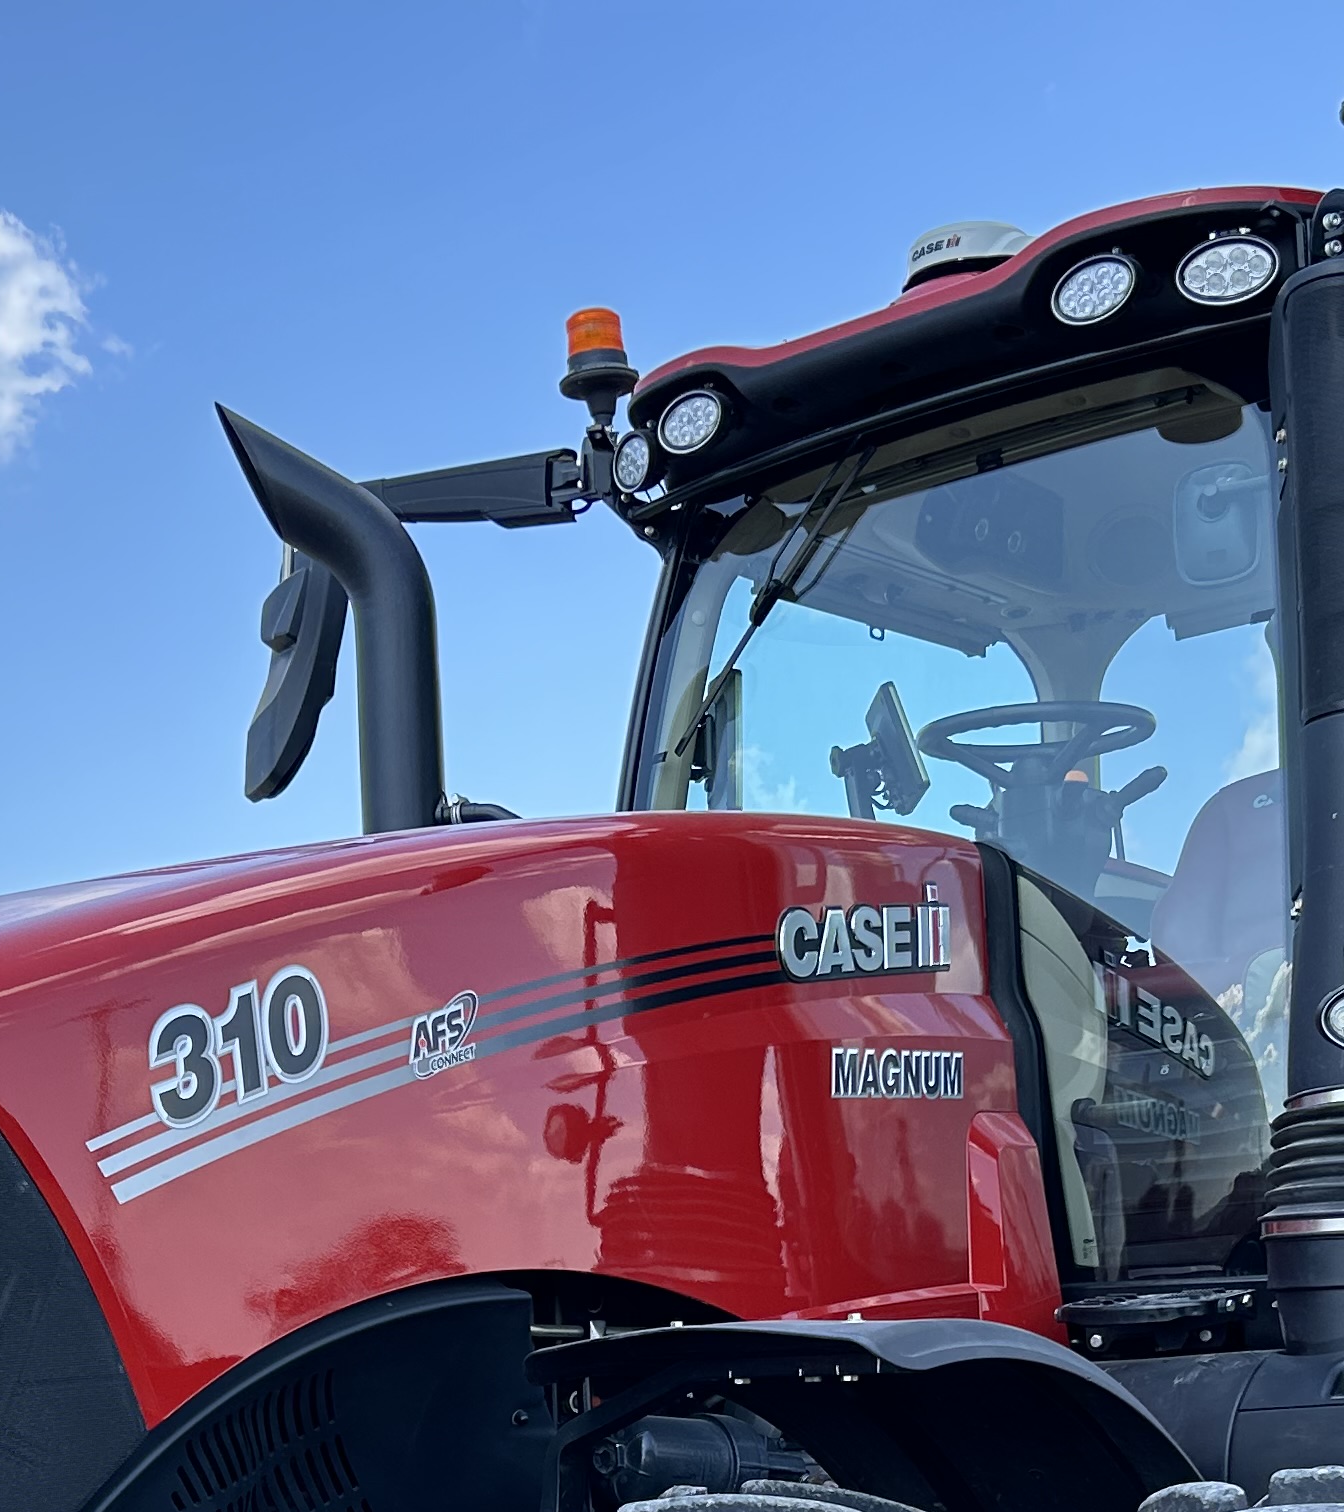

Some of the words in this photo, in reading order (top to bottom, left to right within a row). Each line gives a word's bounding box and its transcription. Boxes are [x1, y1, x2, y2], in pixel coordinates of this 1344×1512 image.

[911, 239, 945, 262] CASE
[778, 903, 913, 979] CASE
[148, 963, 330, 1130] 310
[410, 1004, 466, 1064] AFS
[430, 1044, 475, 1072] CONNECT
[830, 1046, 965, 1099] MAGNUM
